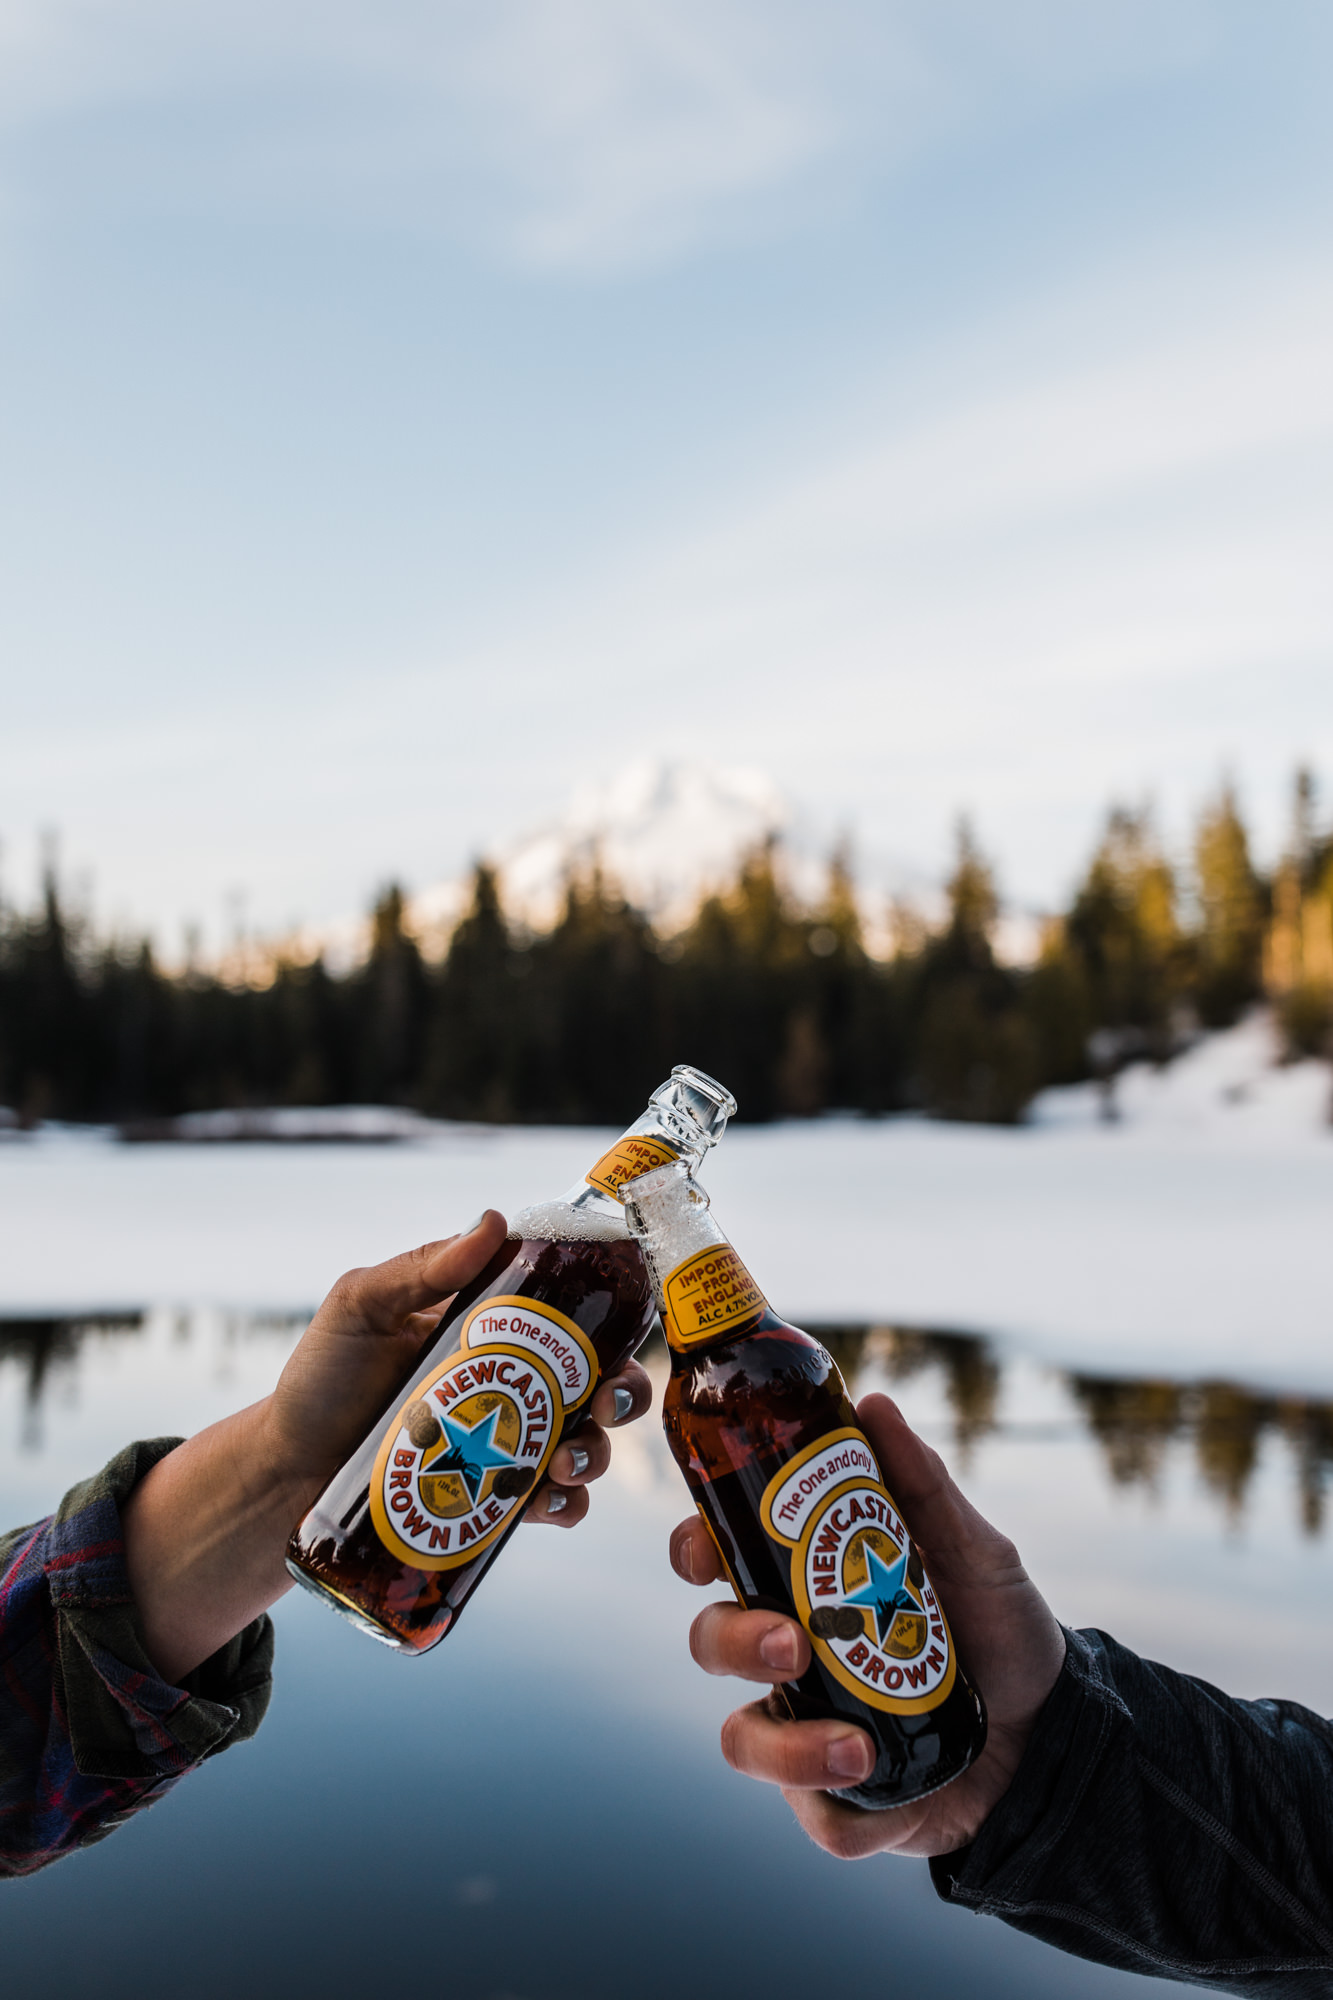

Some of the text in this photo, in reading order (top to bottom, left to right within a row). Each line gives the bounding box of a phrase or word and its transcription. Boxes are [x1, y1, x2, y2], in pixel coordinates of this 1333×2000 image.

[693, 1277, 754, 1314] ENGLAND
[698, 1308, 724, 1326] ALC
[725, 1296, 747, 1314] 4.7%
[701, 1268, 739, 1293] FROM
[479, 1316, 582, 1388] The One and Only
[433, 1360, 548, 1458] NEWCASTLE
[389, 1449, 451, 1550] BROWN
[459, 1500, 504, 1546] ALE
[778, 1492, 805, 1522] The
[799, 1465, 829, 1496] One
[826, 1449, 851, 1475] and
[850, 1449, 872, 1473] Only
[813, 1495, 905, 1597] NEWCASTLE
[845, 1641, 945, 1690] BROWN
[924, 1588, 946, 1645] ALE
